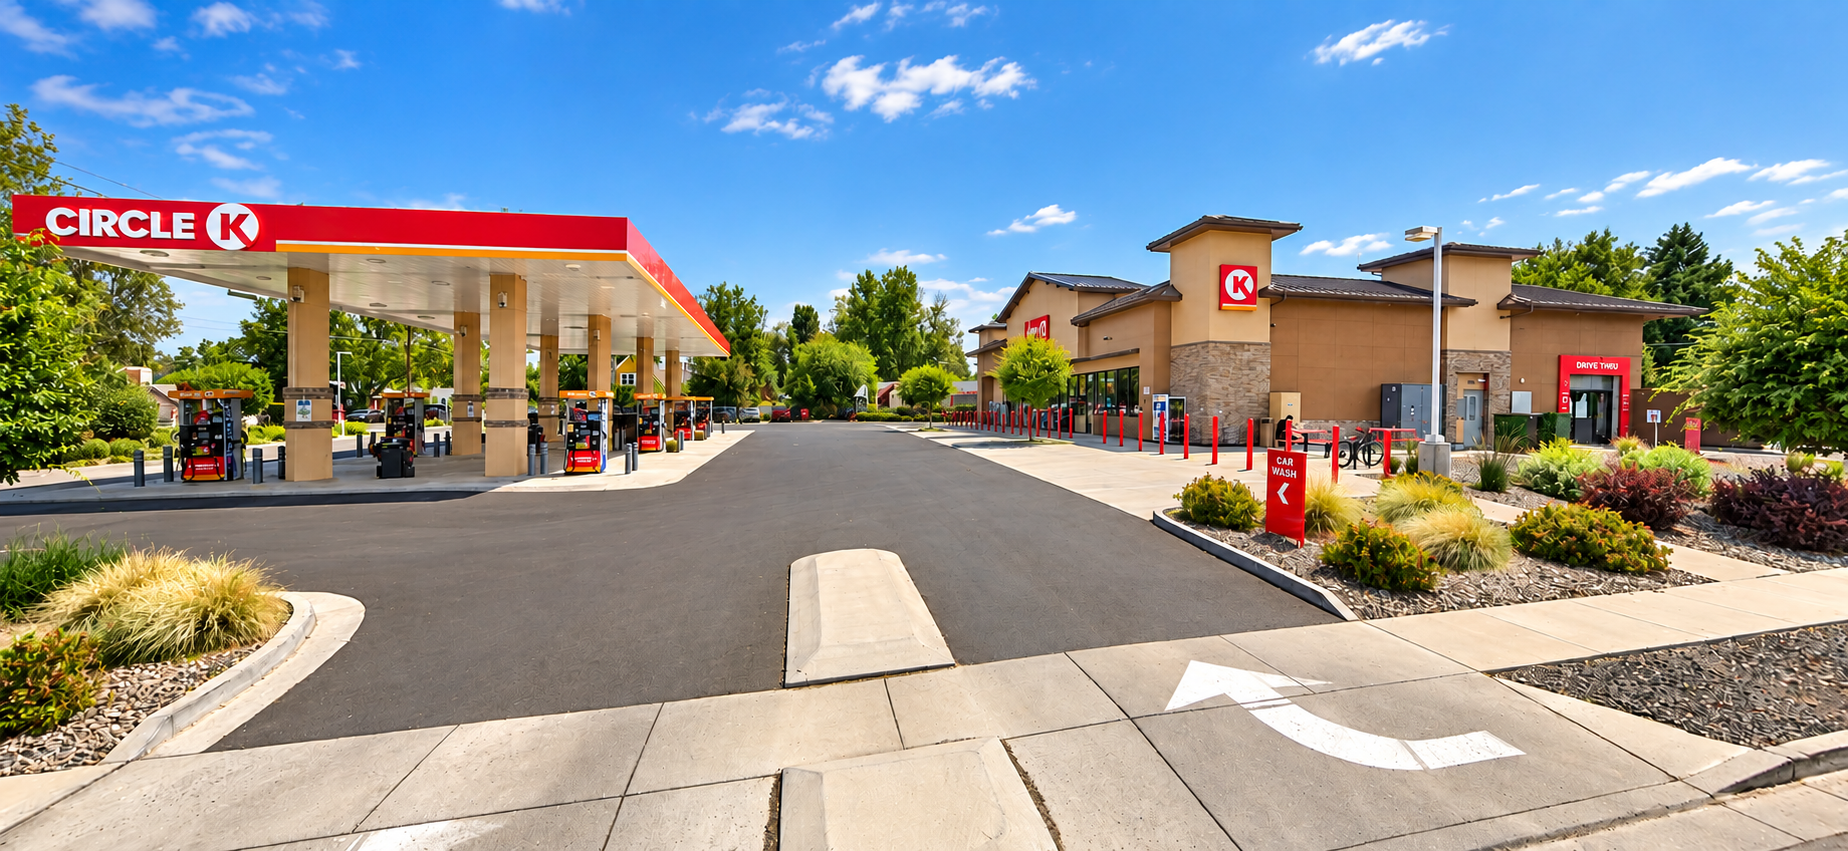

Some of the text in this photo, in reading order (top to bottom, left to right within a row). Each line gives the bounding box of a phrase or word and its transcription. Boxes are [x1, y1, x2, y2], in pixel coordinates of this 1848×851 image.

[45, 207, 257, 250] CIRCLE K
[1230, 274, 1252, 299] K
[1576, 361, 1598, 370] DRIVE
[1276, 456, 1294, 467] CAR
[1271, 466, 1297, 479] WASH
